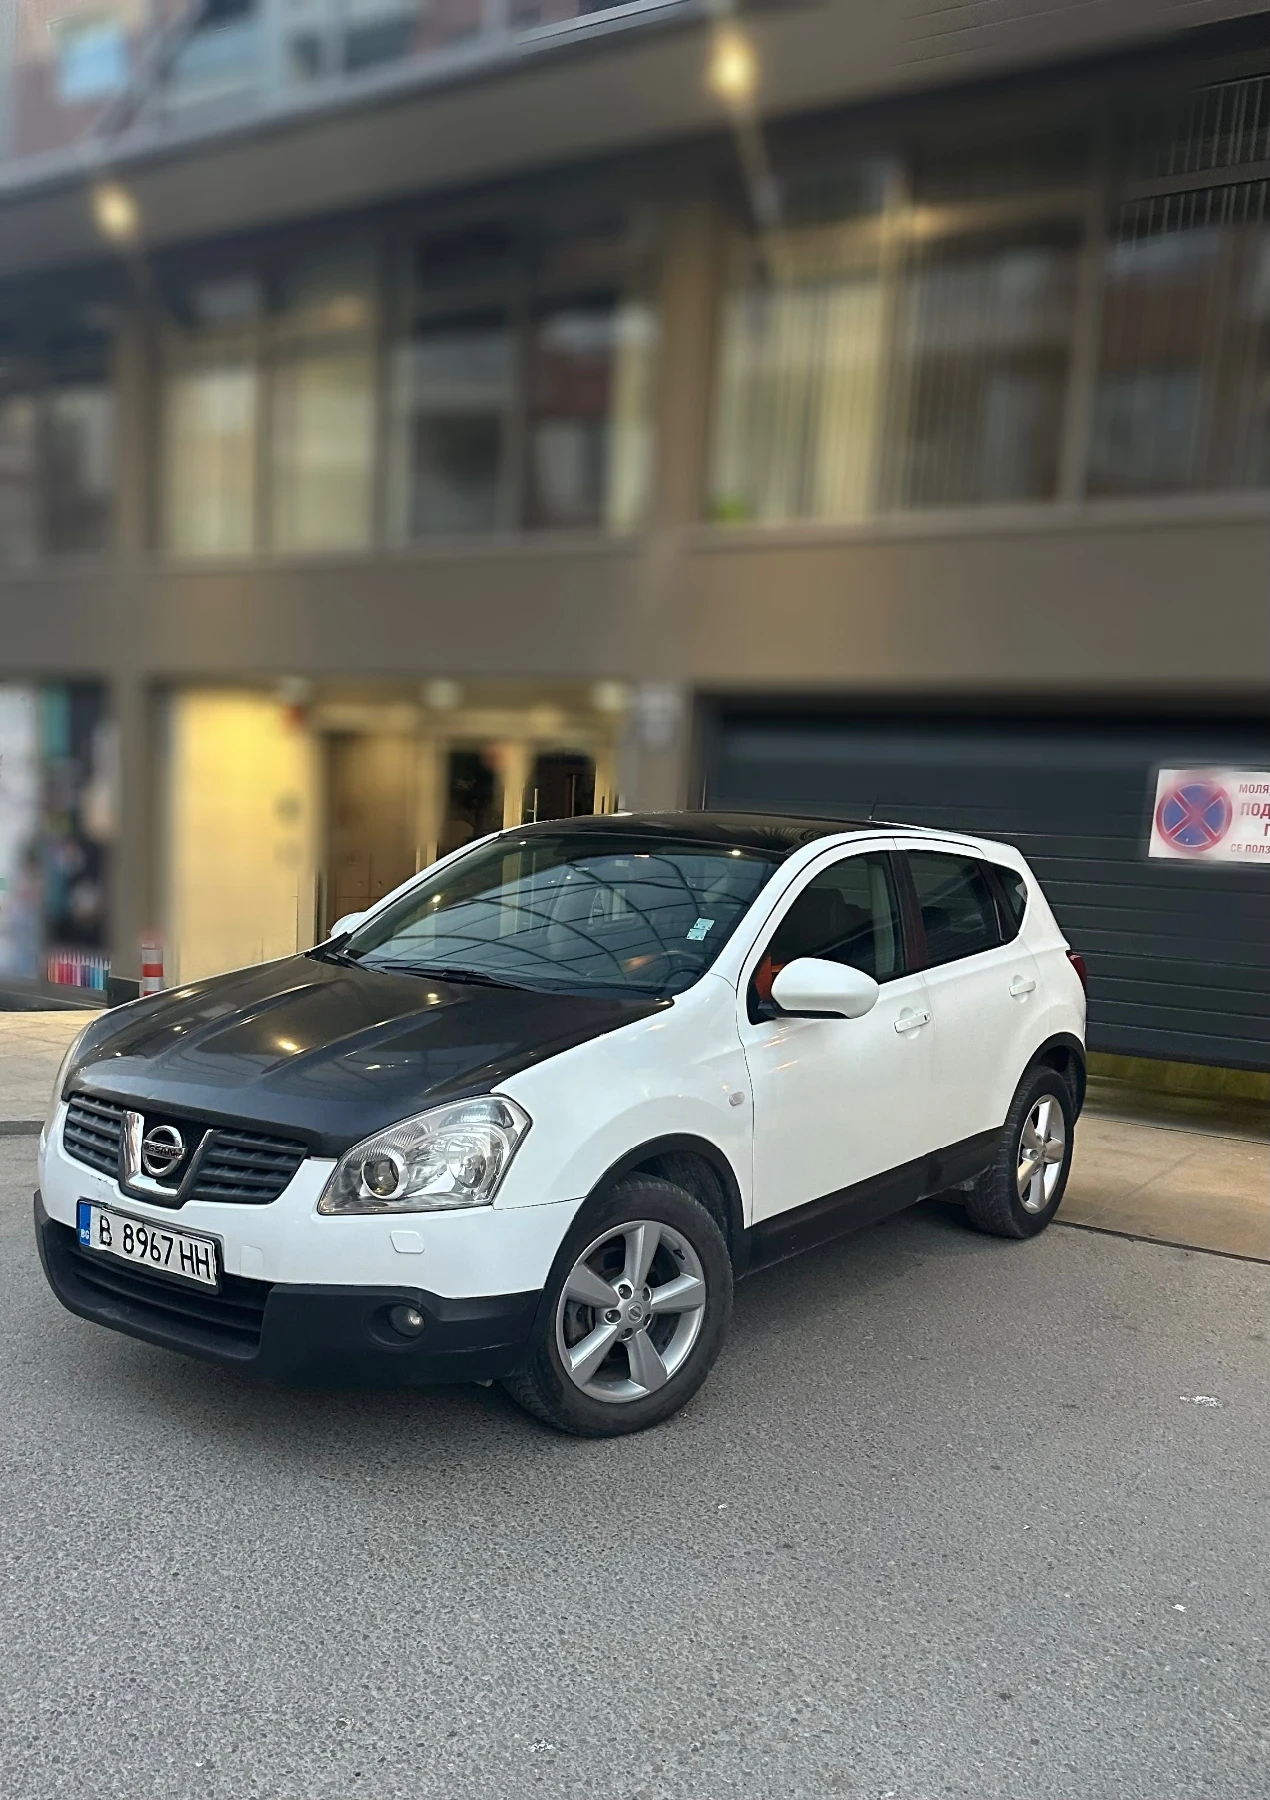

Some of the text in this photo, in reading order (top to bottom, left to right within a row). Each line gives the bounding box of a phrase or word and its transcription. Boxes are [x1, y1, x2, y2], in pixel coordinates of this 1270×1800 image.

[1230, 843, 1243, 853] СЕ
[80, 1229, 90, 1240] BG
[123, 1223, 174, 1265] 8967
